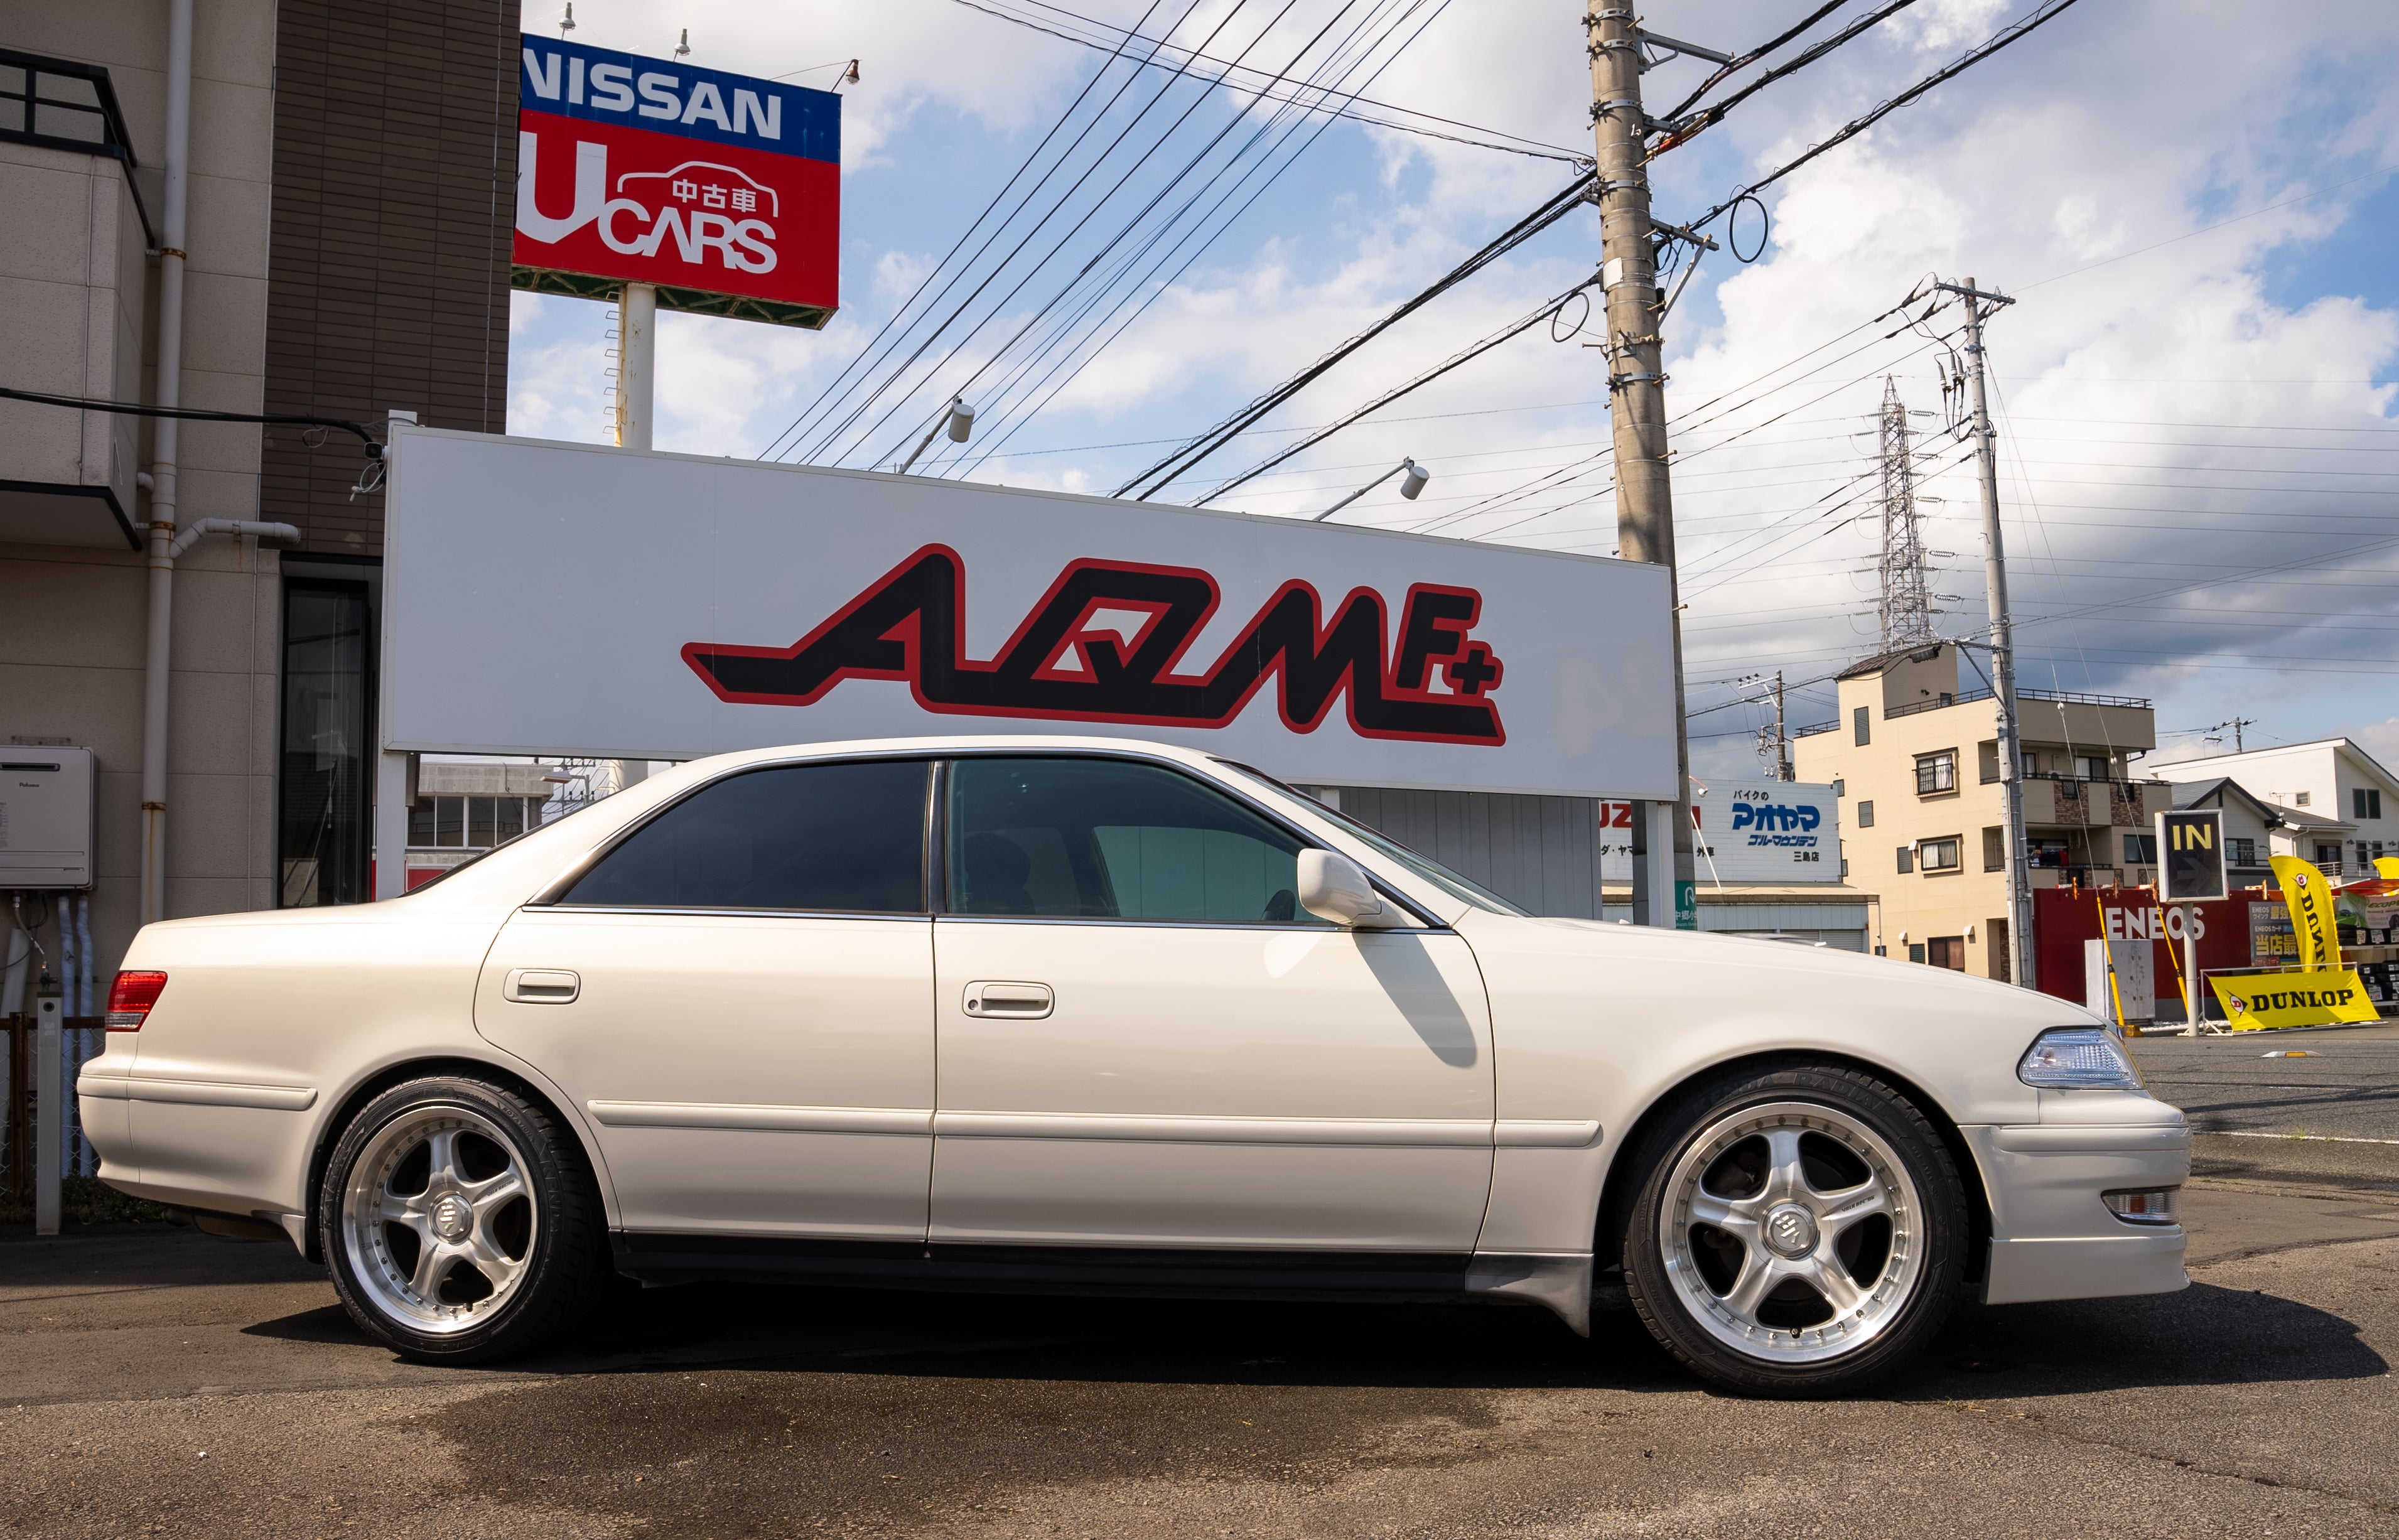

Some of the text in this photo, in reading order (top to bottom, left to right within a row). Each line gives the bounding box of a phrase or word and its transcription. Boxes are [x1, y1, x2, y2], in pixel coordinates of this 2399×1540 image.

[523, 48, 782, 141] NISSAN
[672, 179, 757, 213] 中古車
[598, 197, 778, 275] CARS
[1733, 790, 1769, 801] バイクの
[1732, 802, 1821, 832] アオヤマ
[2172, 824, 2212, 850] IN
[1793, 851, 1819, 863] 三島店
[2105, 907, 2205, 940] ENEOS
[2270, 905, 2291, 920] 最強
[2251, 989, 2354, 1012] DUNLOP
